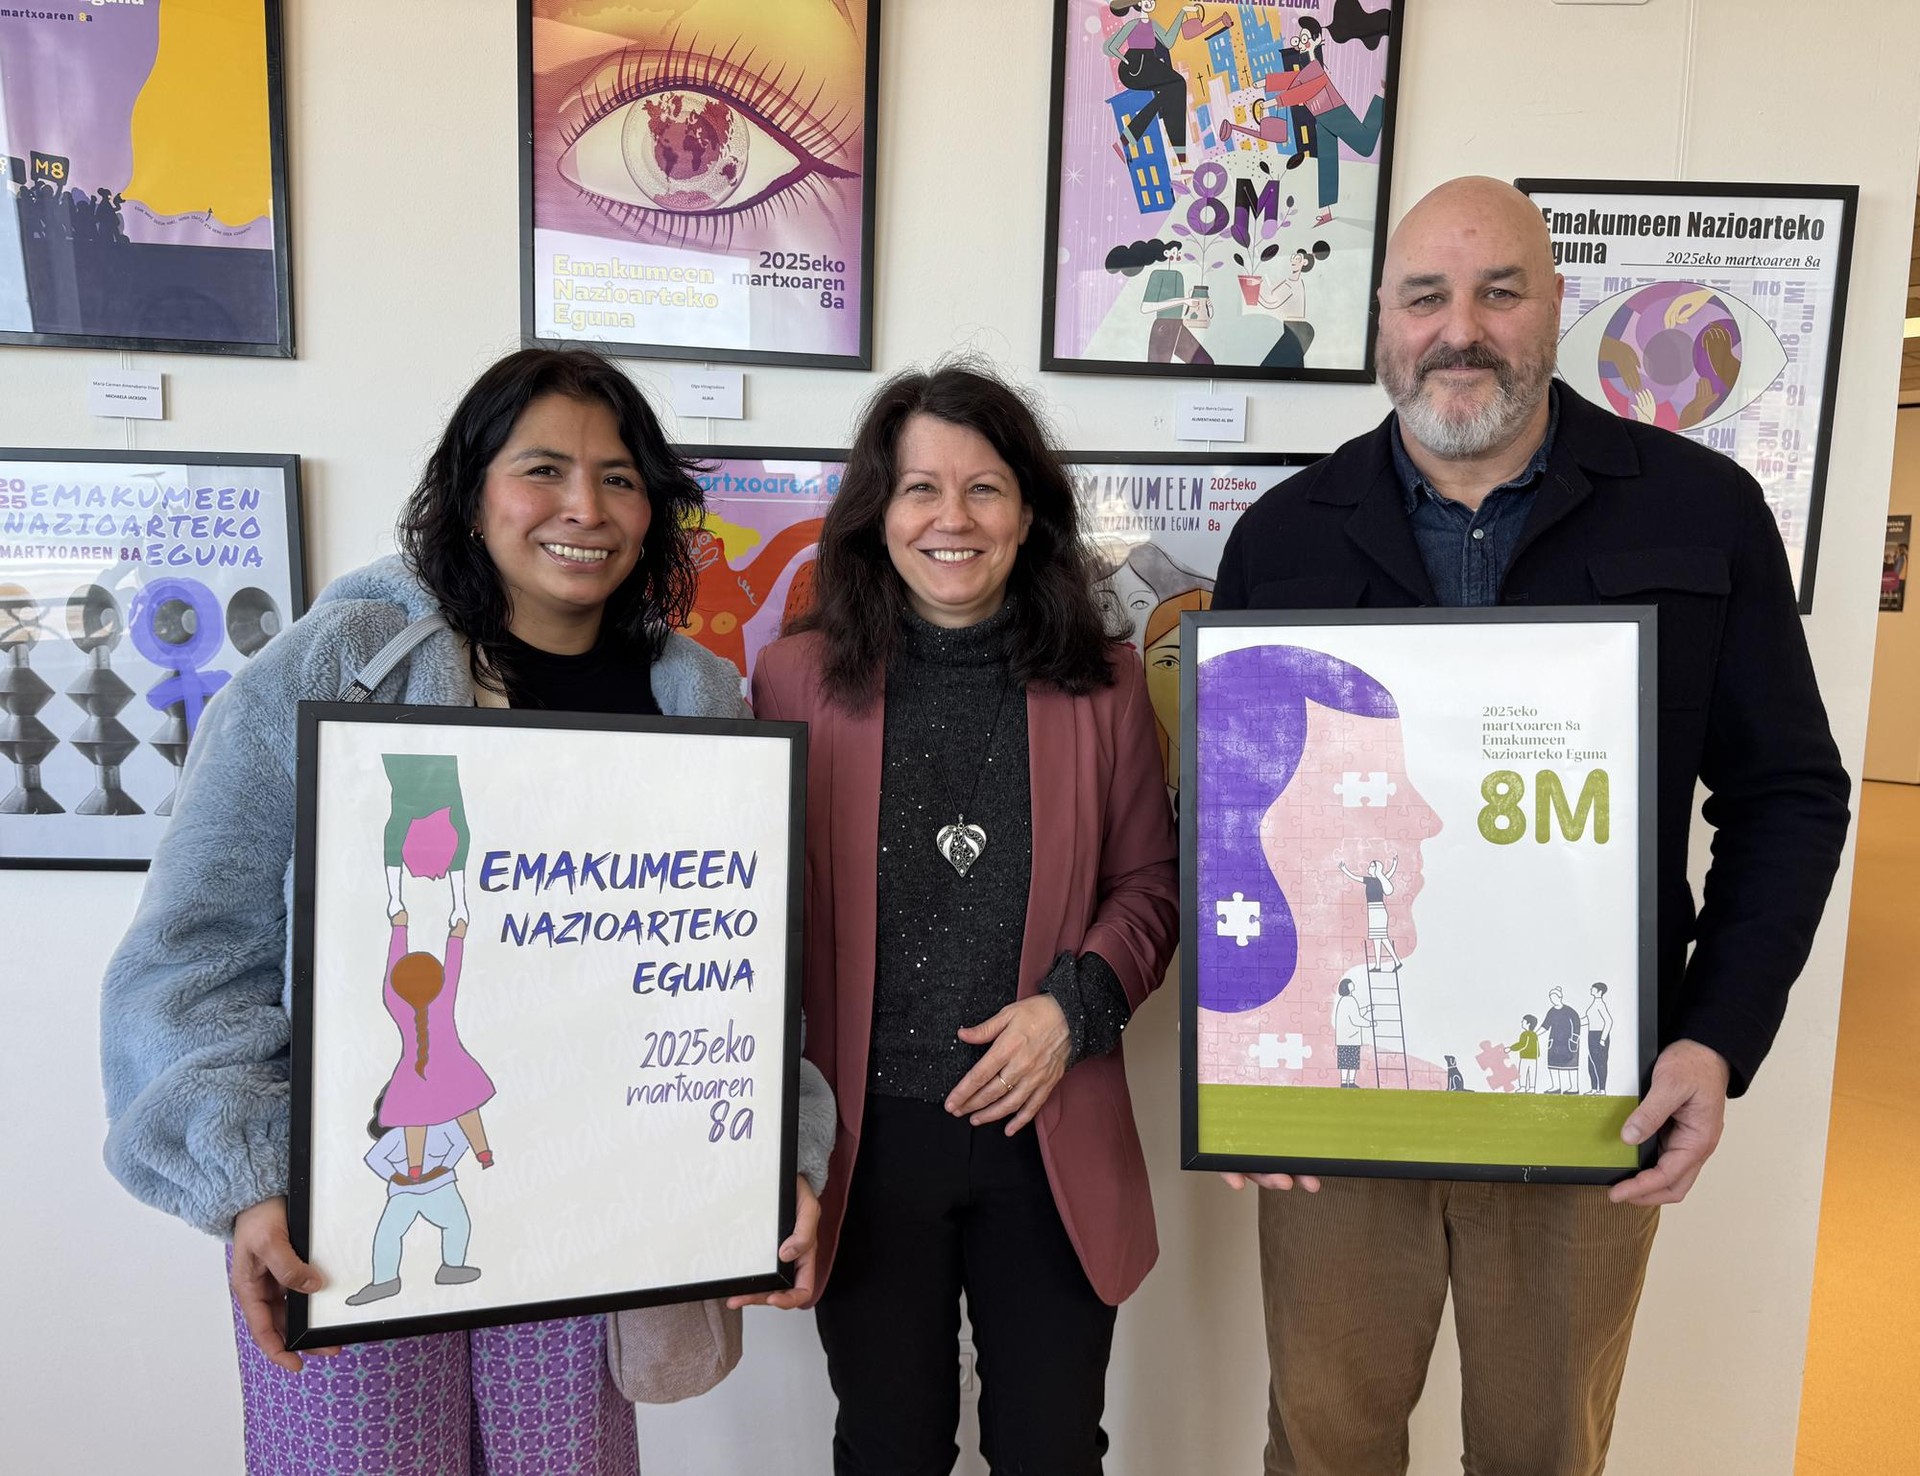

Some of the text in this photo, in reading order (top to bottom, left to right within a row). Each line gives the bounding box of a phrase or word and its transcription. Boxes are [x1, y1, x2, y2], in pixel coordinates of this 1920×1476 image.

[1, 9, 93, 22] martxoaren 8a
[35, 158, 65, 179] M8
[1187, 162, 1280, 244] 8M
[1687, 212, 1825, 241] Nazioarteko
[759, 251, 846, 273] 2025eko
[1551, 241, 1608, 266] guna
[1666, 252, 1821, 268] 2025eko martxoaren 8a
[552, 254, 715, 284] Emakumeen
[553, 278, 719, 309] Nazioarteko
[731, 272, 845, 291] martxoaren
[819, 291, 845, 310] 8a
[553, 303, 635, 332] Eguna
[696, 472, 841, 496] artxoaren 8
[1080, 475, 1204, 511] MAKUMEEN
[1210, 477, 1257, 491] 2025eko
[30, 484, 260, 511] EMAKUMEEN
[3, 511, 262, 539] NAZIOARTEKO
[1171, 516, 1201, 532] EGUNA
[1207, 518, 1221, 532] 8a
[0, 544, 143, 561] MARTXOAREN 8A
[146, 543, 264, 567] EGUNA
[1482, 705, 1538, 717] 2025eko
[1482, 720, 1581, 732] martxoaren 8a
[1482, 734, 1566, 746] Emakumeen
[1482, 748, 1608, 763] Nazioarteko Eguna
[1477, 768, 1610, 845] 8M
[479, 850, 758, 896] EMAKUMEEN
[500, 908, 759, 948] NAZIOARTEKO
[631, 958, 755, 997] EGUNA
[640, 1018, 756, 1069] 2025eko
[626, 1072, 754, 1106] martxoaren
[708, 1099, 754, 1143] 8a
